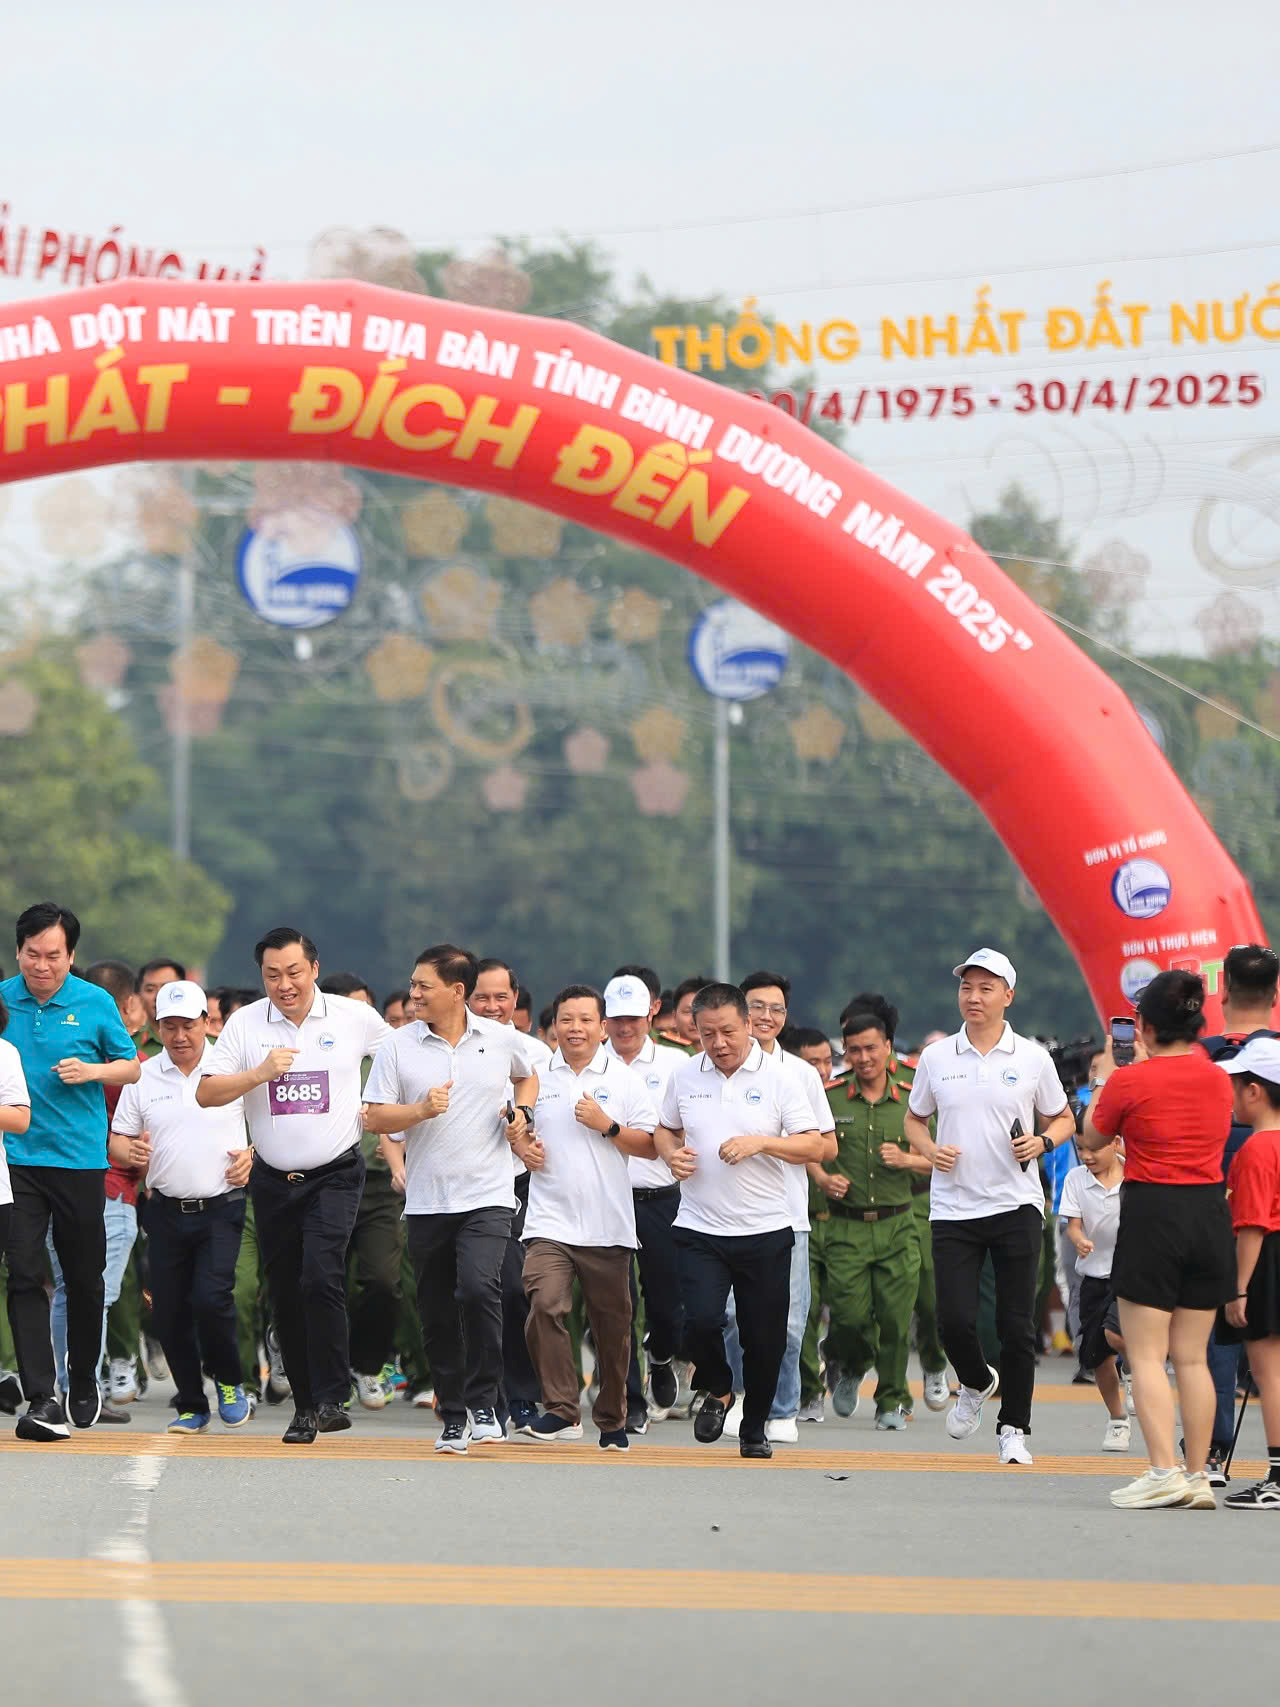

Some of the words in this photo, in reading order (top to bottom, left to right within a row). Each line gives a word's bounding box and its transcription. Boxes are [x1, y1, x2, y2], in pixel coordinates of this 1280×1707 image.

[650, 295, 862, 372] THỐNG
[880, 283, 1028, 359] NHẤT
[1045, 278, 1152, 350] ĐẤT
[69, 302, 147, 351] DỘT
[157, 300, 236, 345] NÁT
[251, 303, 352, 349] TRÊN
[362, 313, 428, 362] ĐỊA
[435, 328, 521, 380] BÀN
[532, 349, 623, 410] TỈNH
[619, 382, 715, 450] BÌNH
[716, 423, 844, 520] DƯƠNG
[841, 500, 937, 580] NĂM
[744, 382, 977, 426] 0/4/1975
[1013, 372, 1265, 417] 30/4/2025
[287, 356, 541, 471] ĐÍCH
[550, 422, 752, 549] ĐẾN
[275, 1083, 322, 1103] 8685
